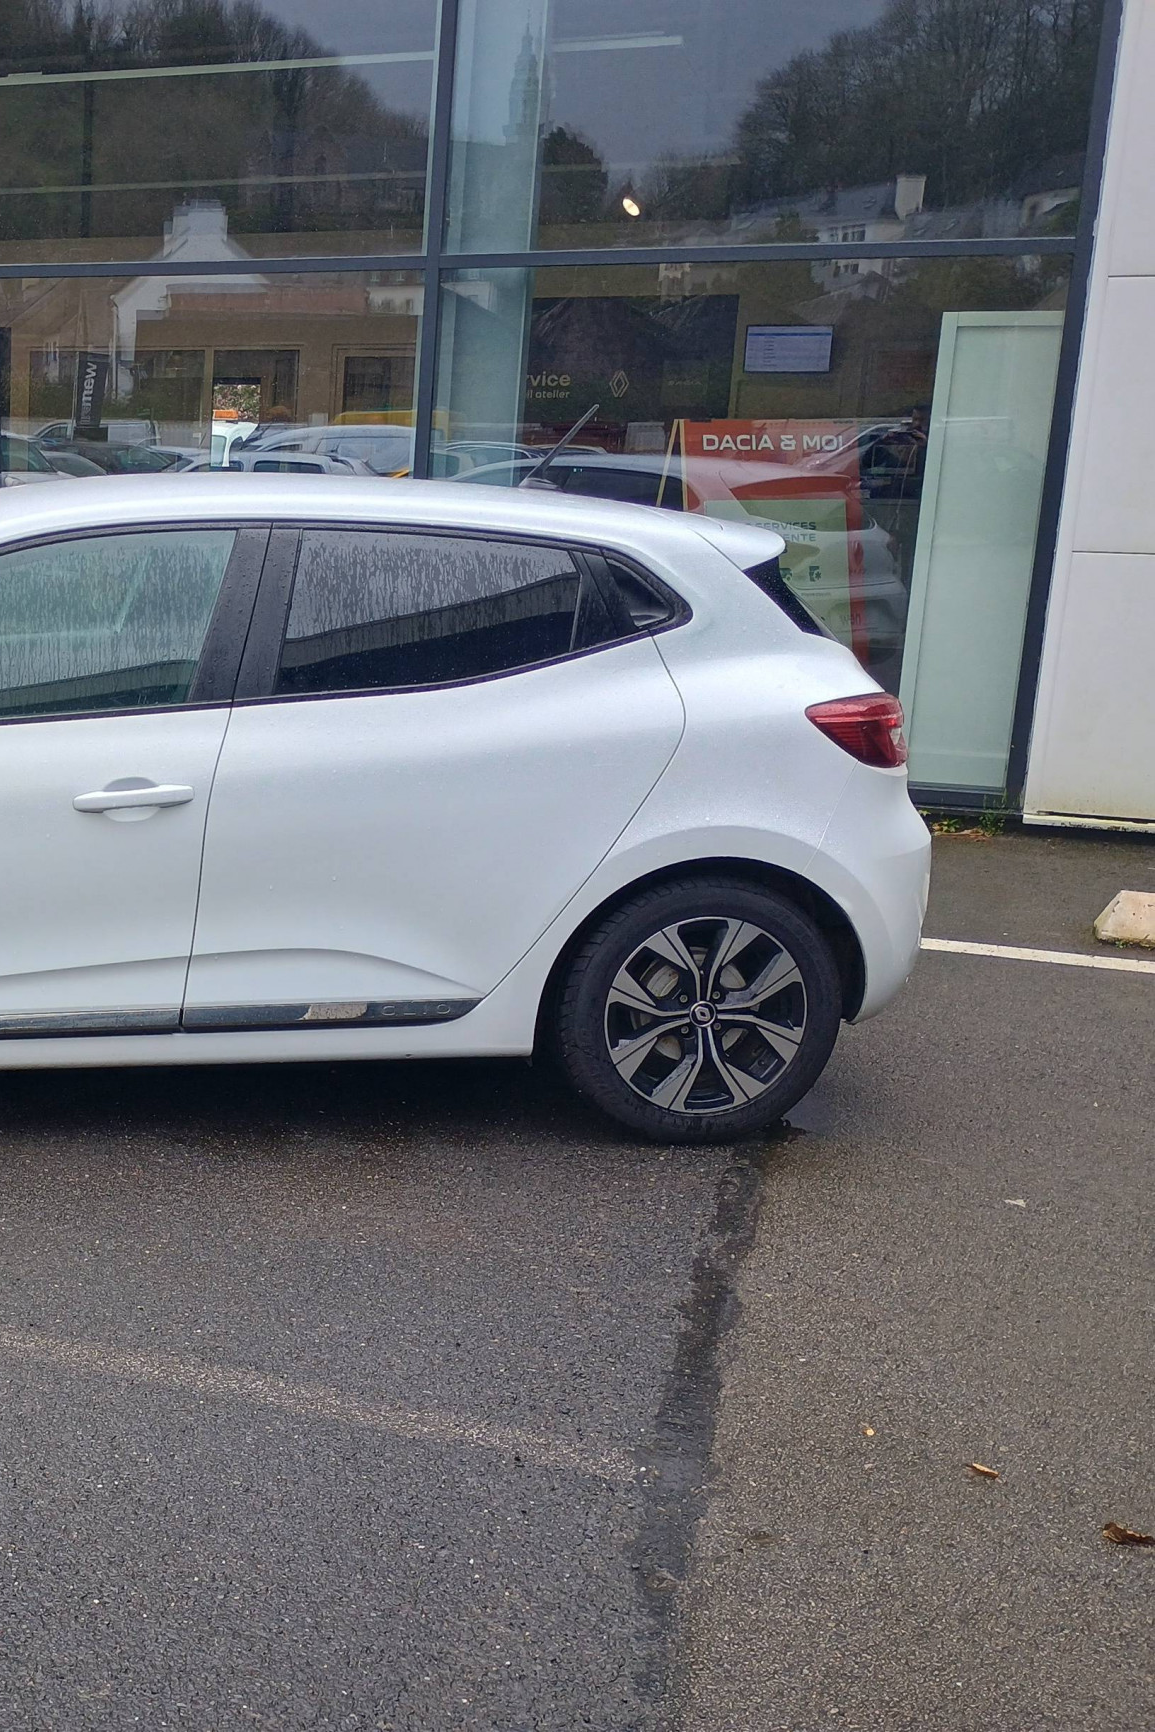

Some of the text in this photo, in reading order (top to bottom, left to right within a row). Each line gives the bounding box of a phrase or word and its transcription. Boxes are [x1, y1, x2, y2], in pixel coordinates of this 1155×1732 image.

[535, 389, 571, 399] atelier
[702, 434, 844, 451] DACIA & MOI
